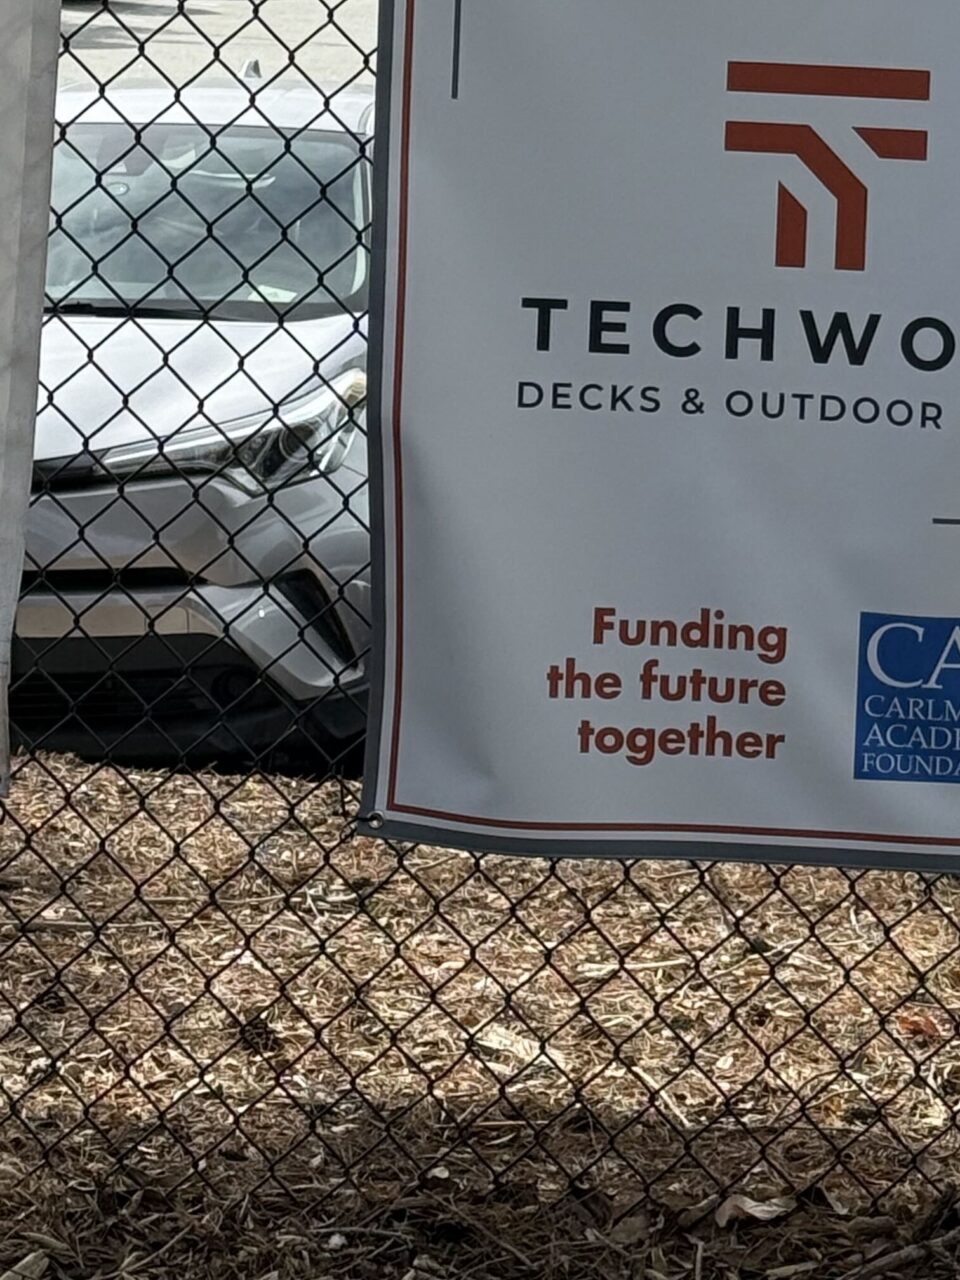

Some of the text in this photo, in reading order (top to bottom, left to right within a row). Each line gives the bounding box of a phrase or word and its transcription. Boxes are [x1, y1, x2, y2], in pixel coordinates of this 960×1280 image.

[517, 381, 661, 413] DECKS
[681, 387, 705, 415] &
[725, 390, 943, 430] OUTDOOR
[592, 606, 788, 665] Funding
[546, 657, 786, 707] the future
[577, 714, 786, 766] together
